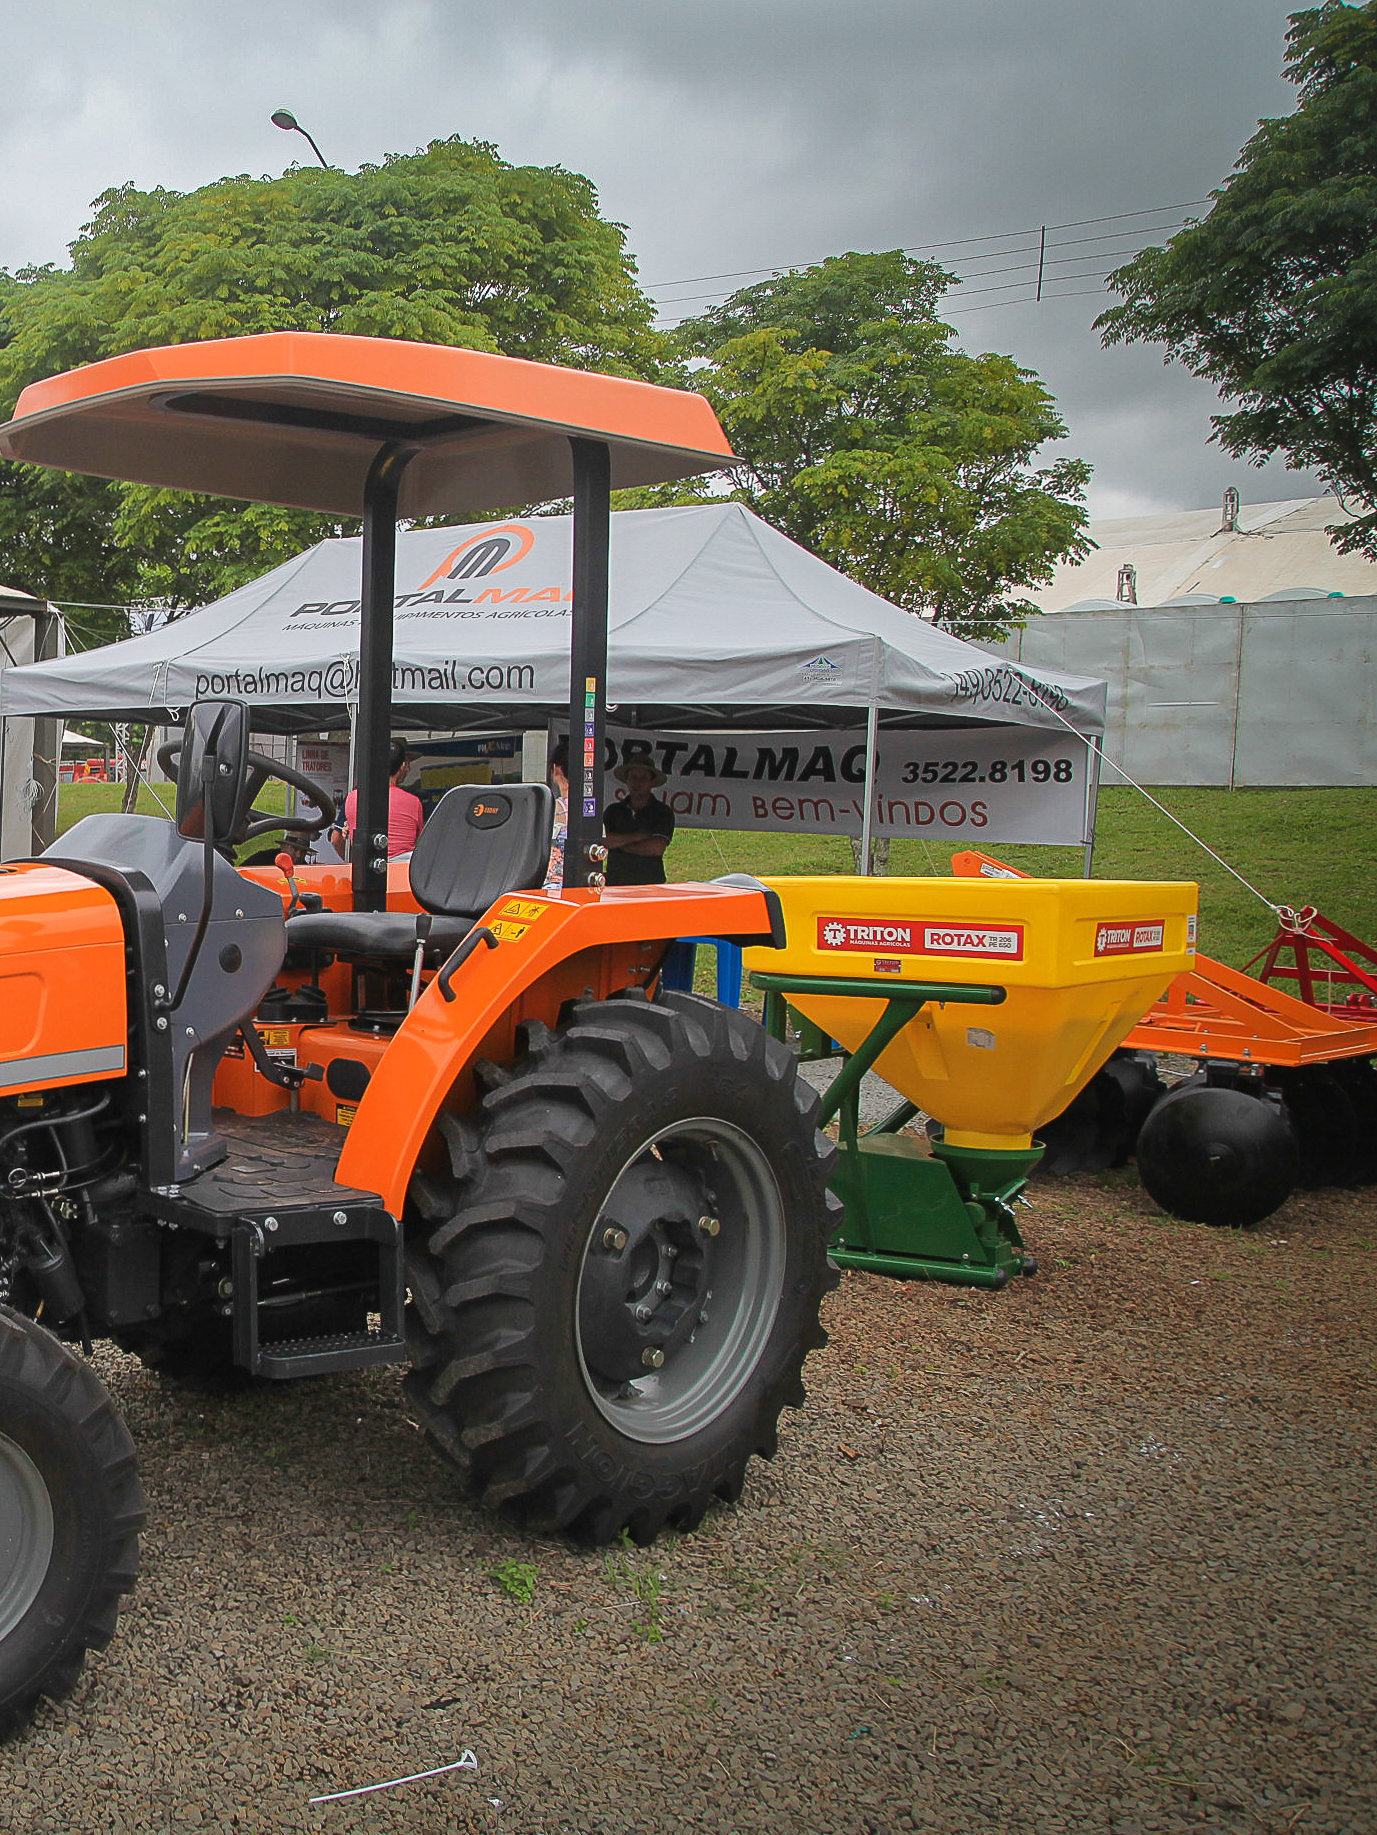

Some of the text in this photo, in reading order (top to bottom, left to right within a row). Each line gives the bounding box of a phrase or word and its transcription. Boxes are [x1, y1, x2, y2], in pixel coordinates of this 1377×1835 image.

[289, 587, 573, 617] POTALMA
[196, 660, 535, 699] portalmaq@tmail.com
[901, 758, 1074, 784] 3522.8198
[846, 925, 911, 942] TRITON
[929, 932, 987, 948] ROTAX
[1106, 929, 1132, 944] TRITON
